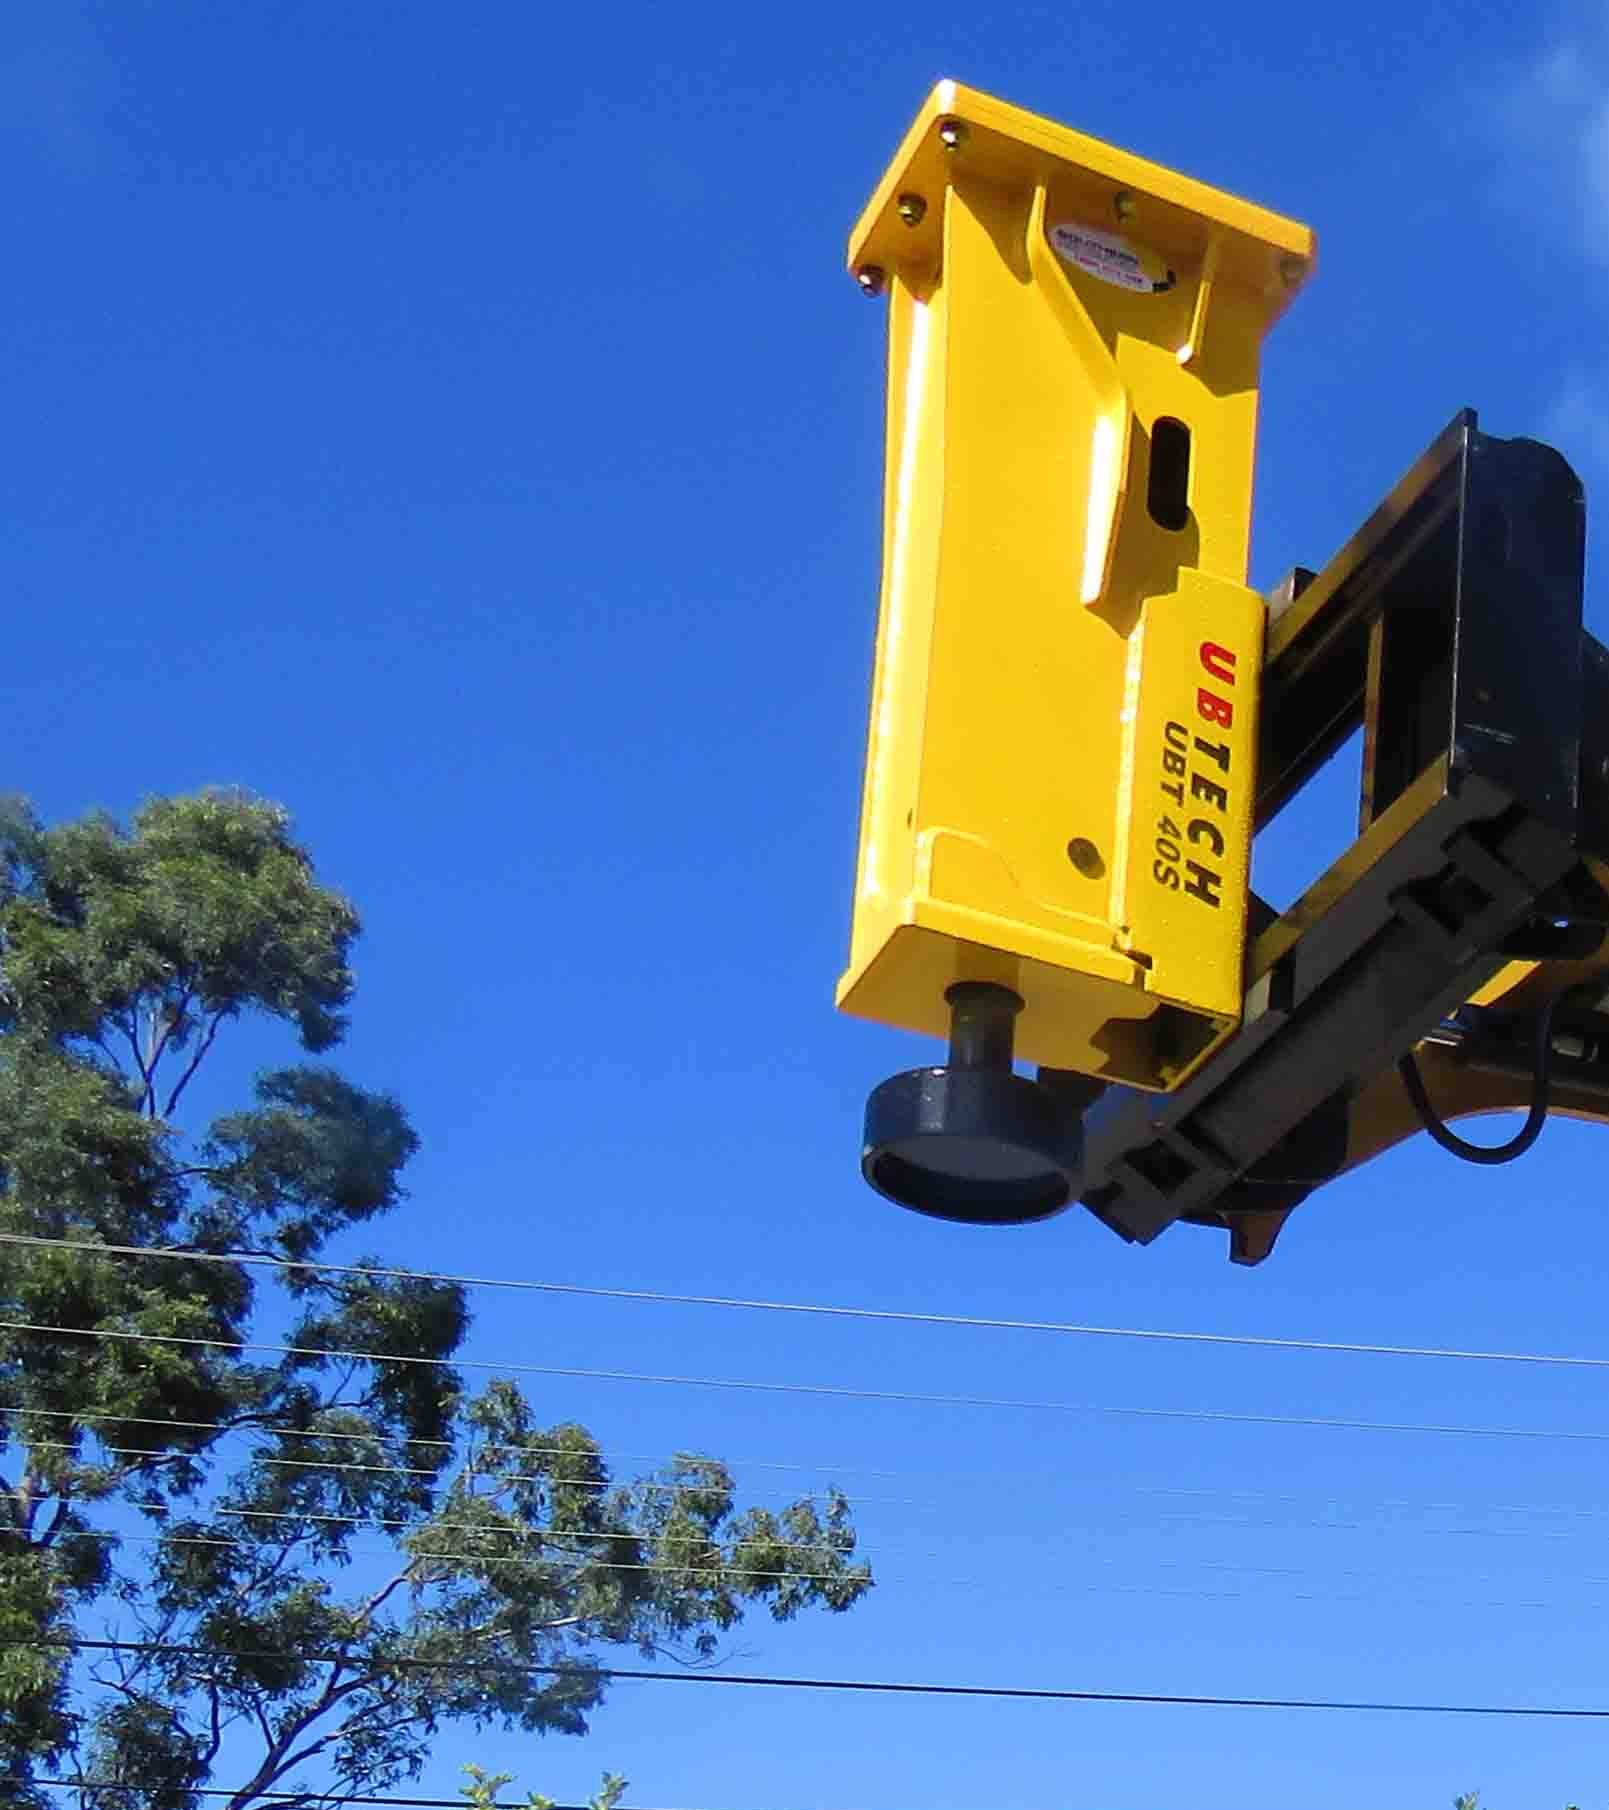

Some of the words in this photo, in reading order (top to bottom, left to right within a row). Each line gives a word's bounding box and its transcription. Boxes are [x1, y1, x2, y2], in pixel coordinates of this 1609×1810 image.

[1160, 720, 1189, 809] UBT
[1183, 640, 1238, 909] UBTECH
[1153, 814, 1183, 892] 40S
